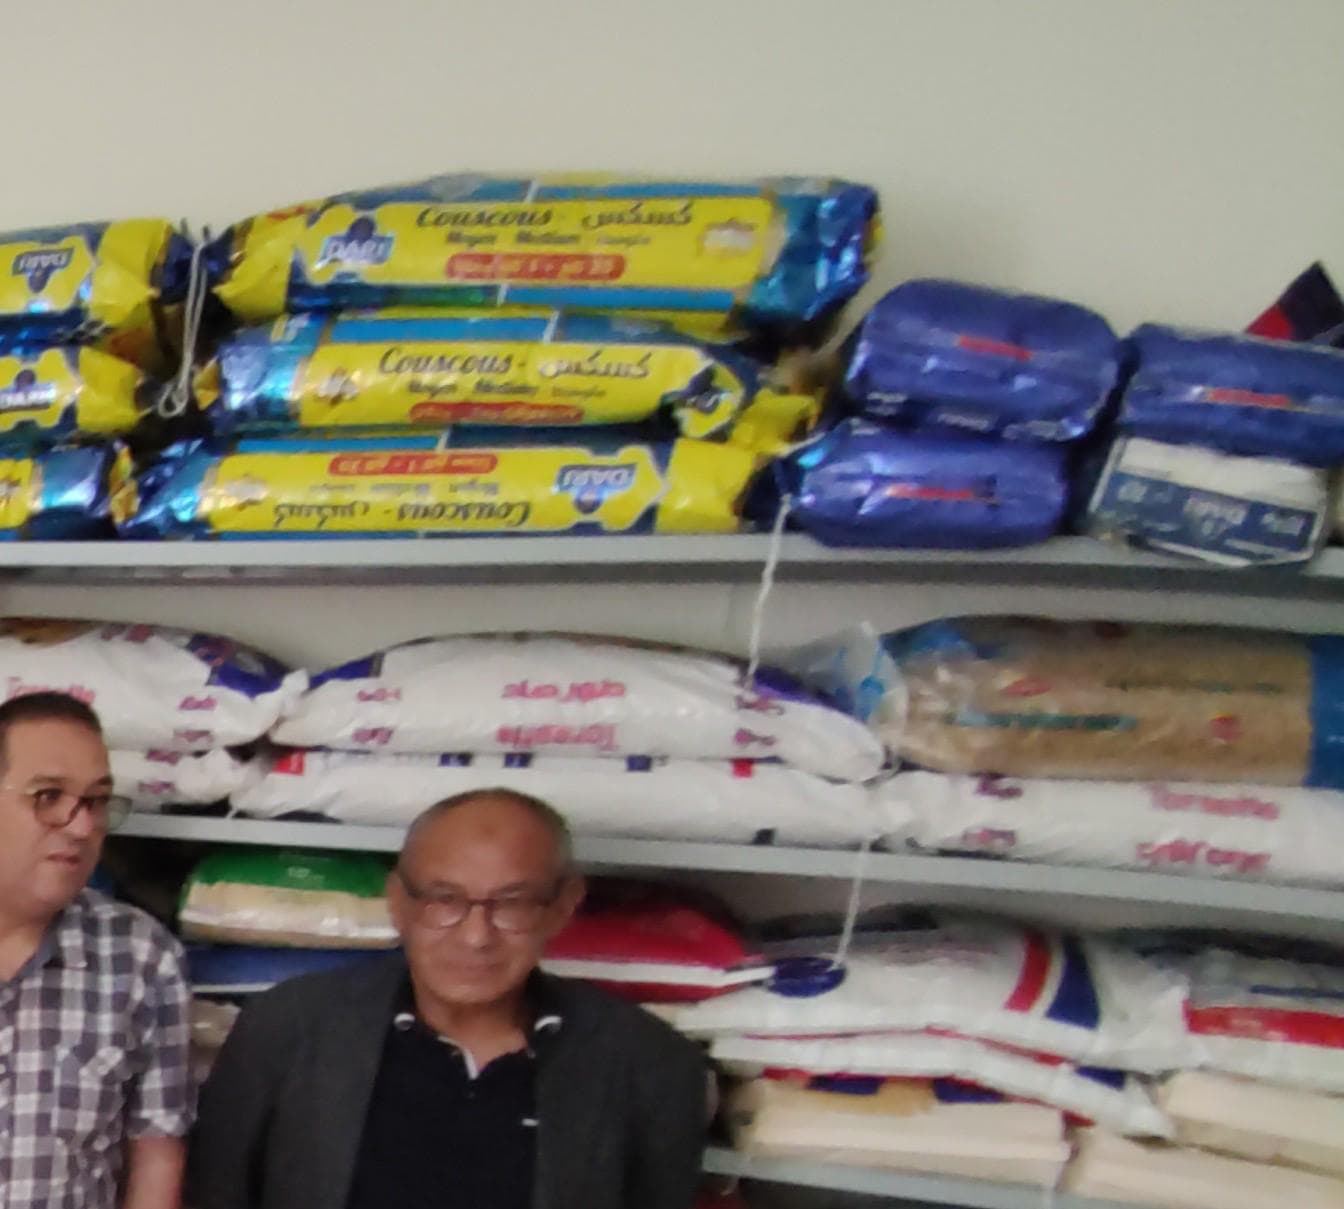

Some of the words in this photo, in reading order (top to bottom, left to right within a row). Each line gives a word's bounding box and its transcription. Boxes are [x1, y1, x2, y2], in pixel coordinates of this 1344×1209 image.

[416, 206, 554, 228] Couscous
[581, 202, 691, 229] كسكس
[18, 250, 71, 270] DARI
[326, 239, 386, 262] DARI
[378, 346, 514, 375] Couscous
[538, 350, 653, 380] كسكس
[564, 467, 631, 487] DARI
[273, 500, 370, 528] كسكس
[396, 500, 531, 527] Couscous
